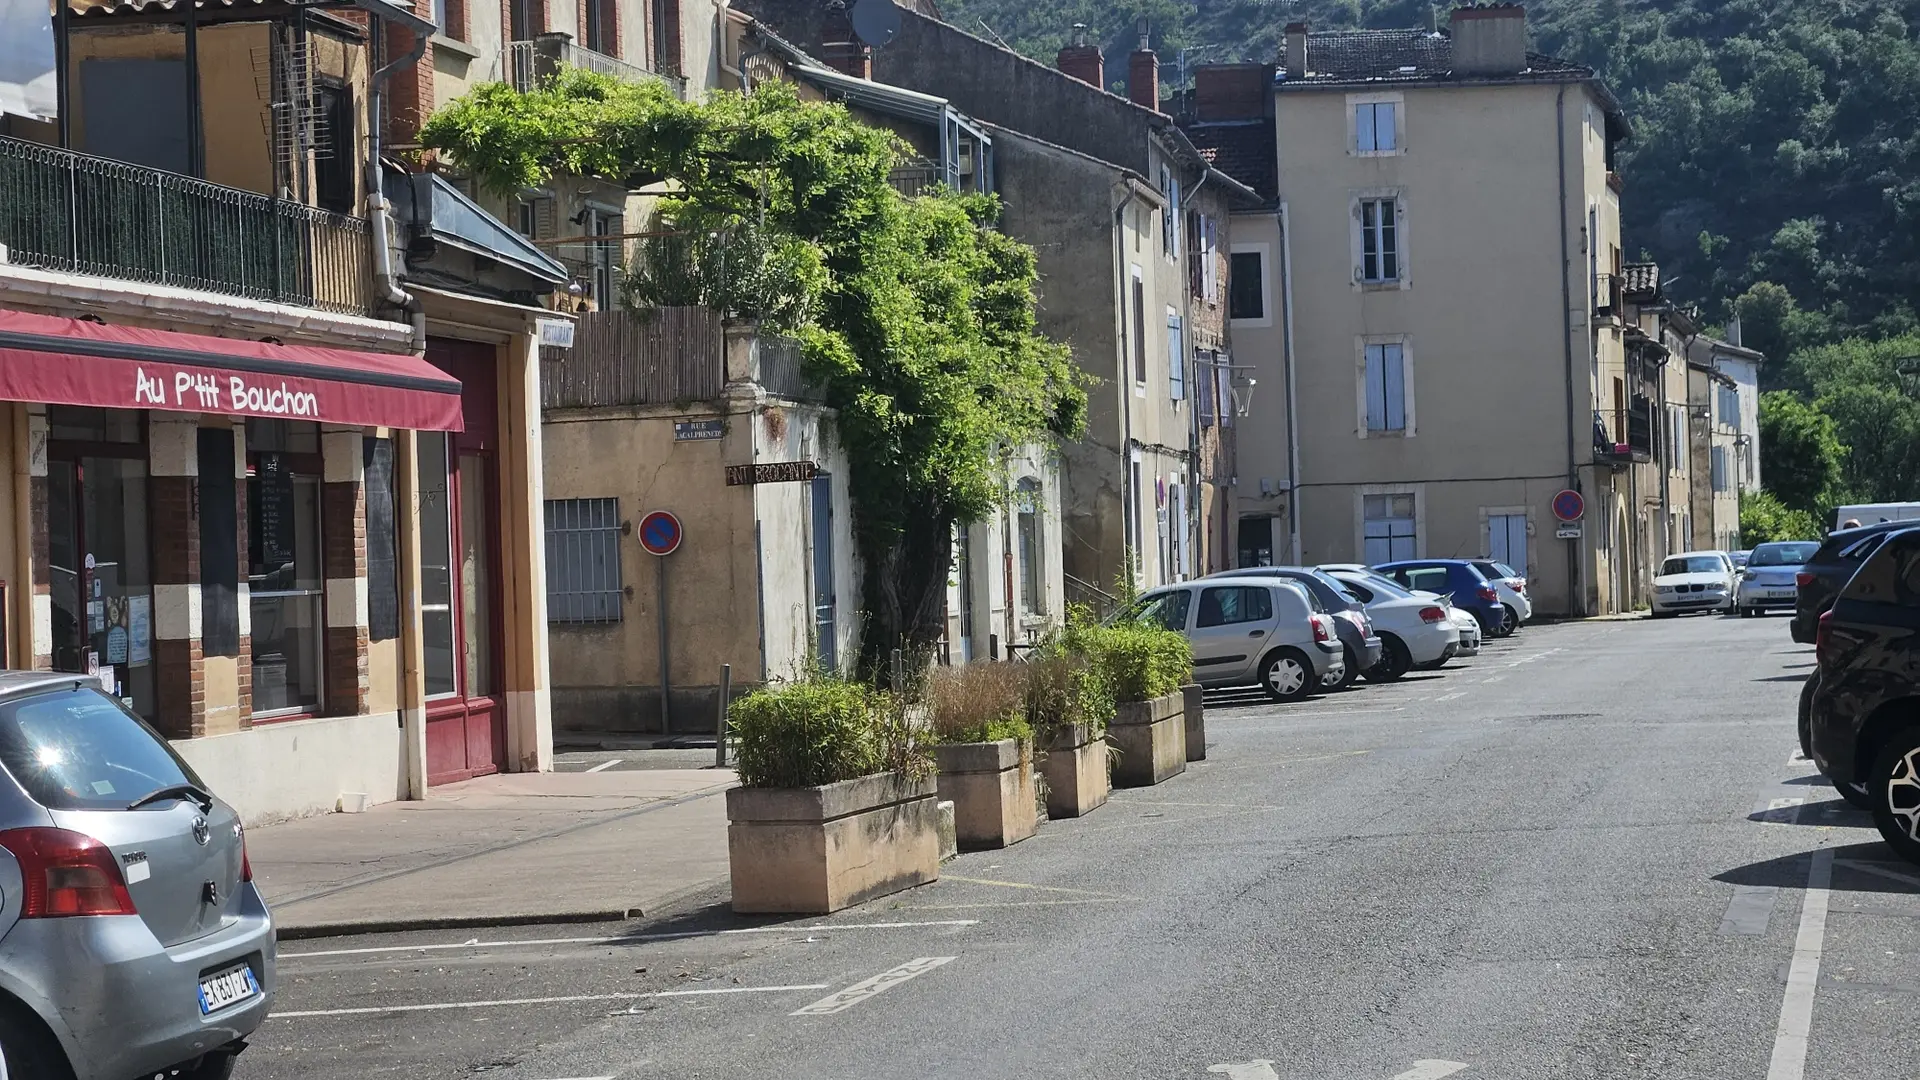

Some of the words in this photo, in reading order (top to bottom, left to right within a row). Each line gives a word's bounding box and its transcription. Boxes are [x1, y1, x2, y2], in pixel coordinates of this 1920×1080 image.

[135, 367, 166, 404] Au
[175, 371, 220, 408] P'tit
[229, 376, 319, 416] Bouchon
[690, 422, 707, 430] RUE
[755, 462, 814, 482] BROCANTE
